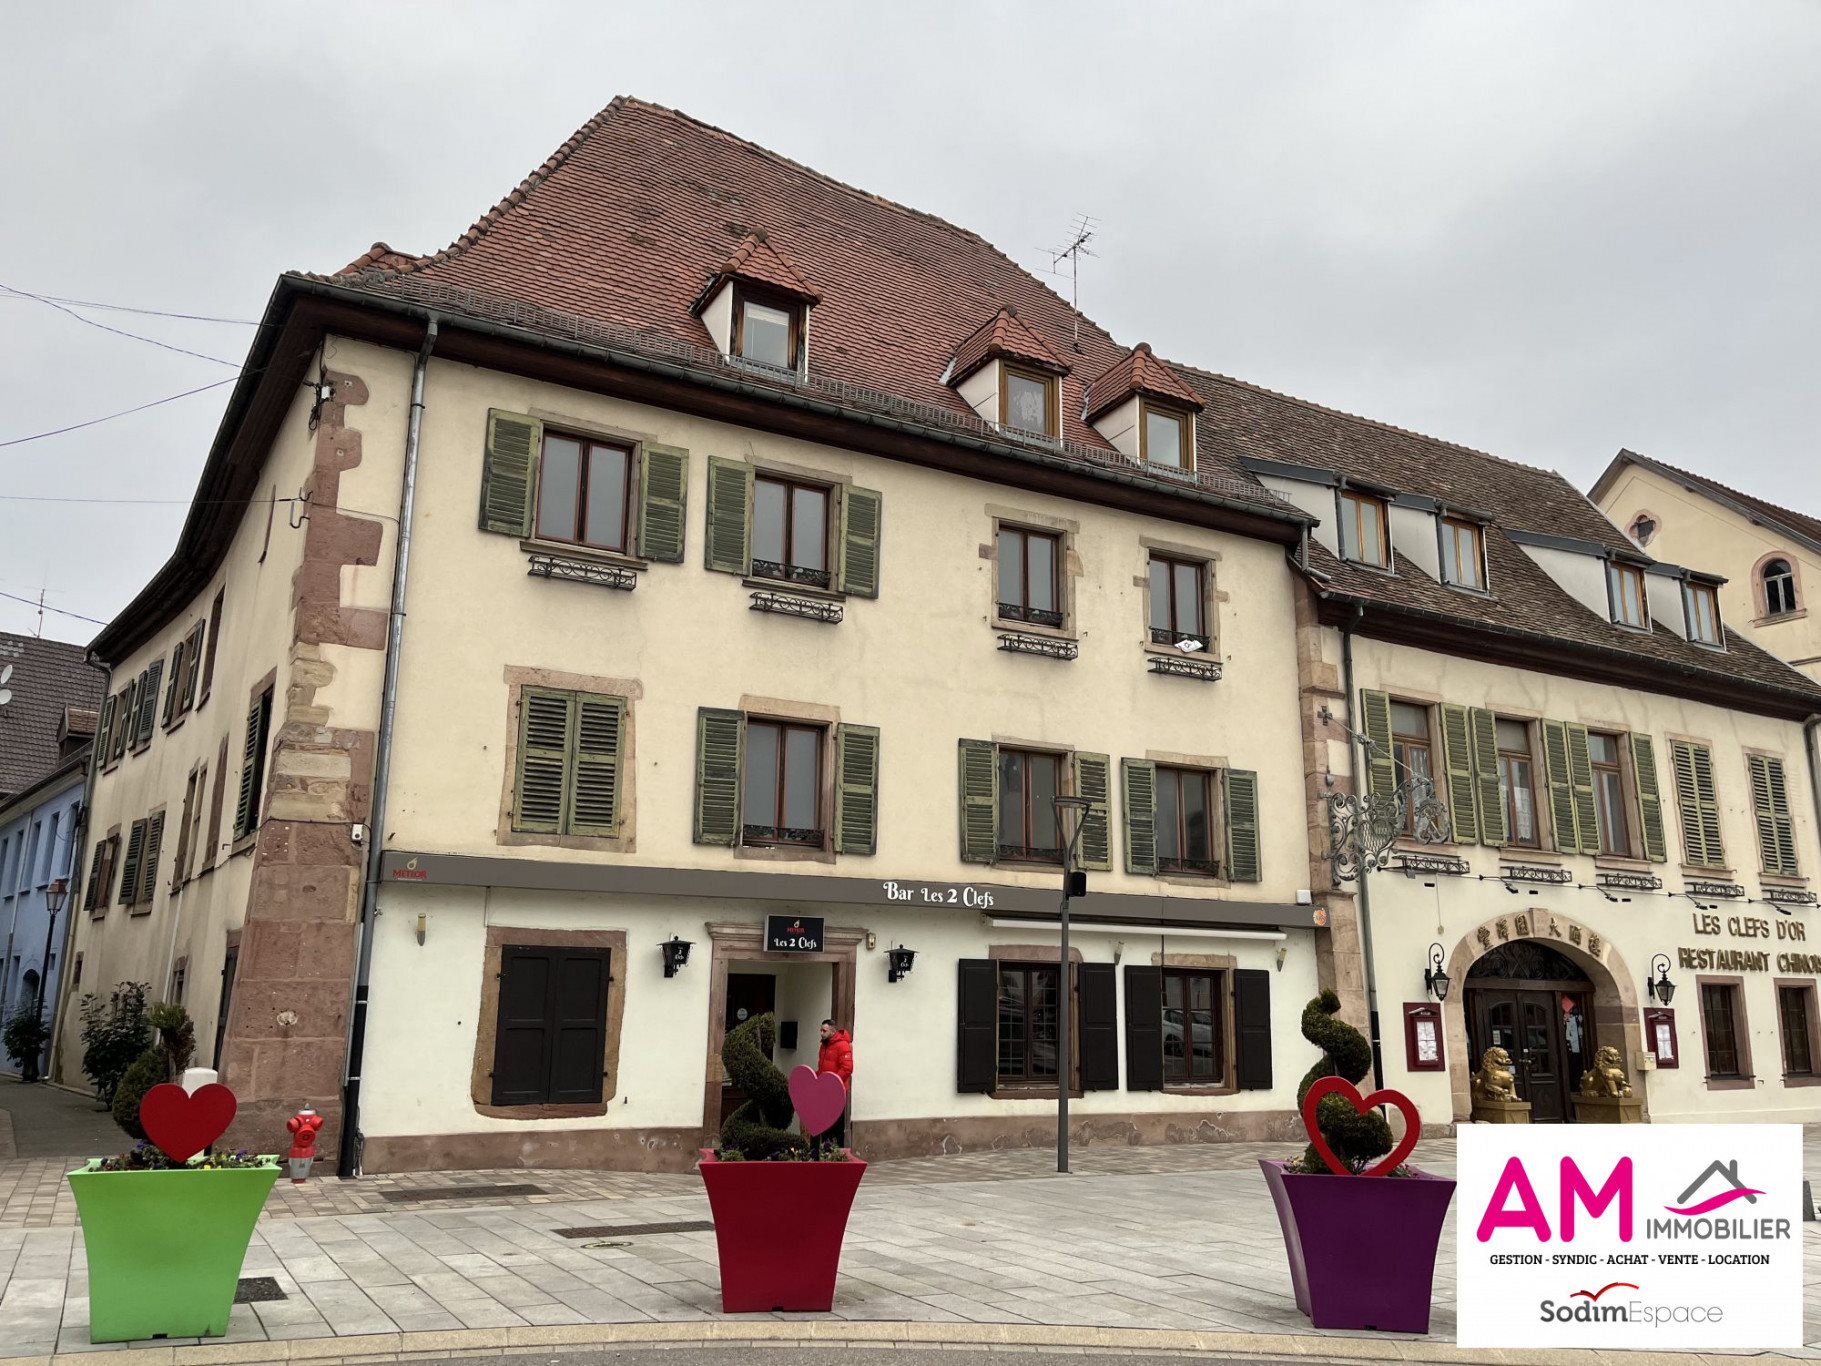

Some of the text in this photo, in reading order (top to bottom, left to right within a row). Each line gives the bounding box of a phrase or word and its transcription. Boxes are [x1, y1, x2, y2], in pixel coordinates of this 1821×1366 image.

[882, 881, 994, 909] Bar Les 2 Clefs
[1692, 912, 1806, 942] LES CLEFS D'OR
[773, 936, 817, 950] Les 2 Clefs
[1677, 946, 1770, 973] RESTAURANT
